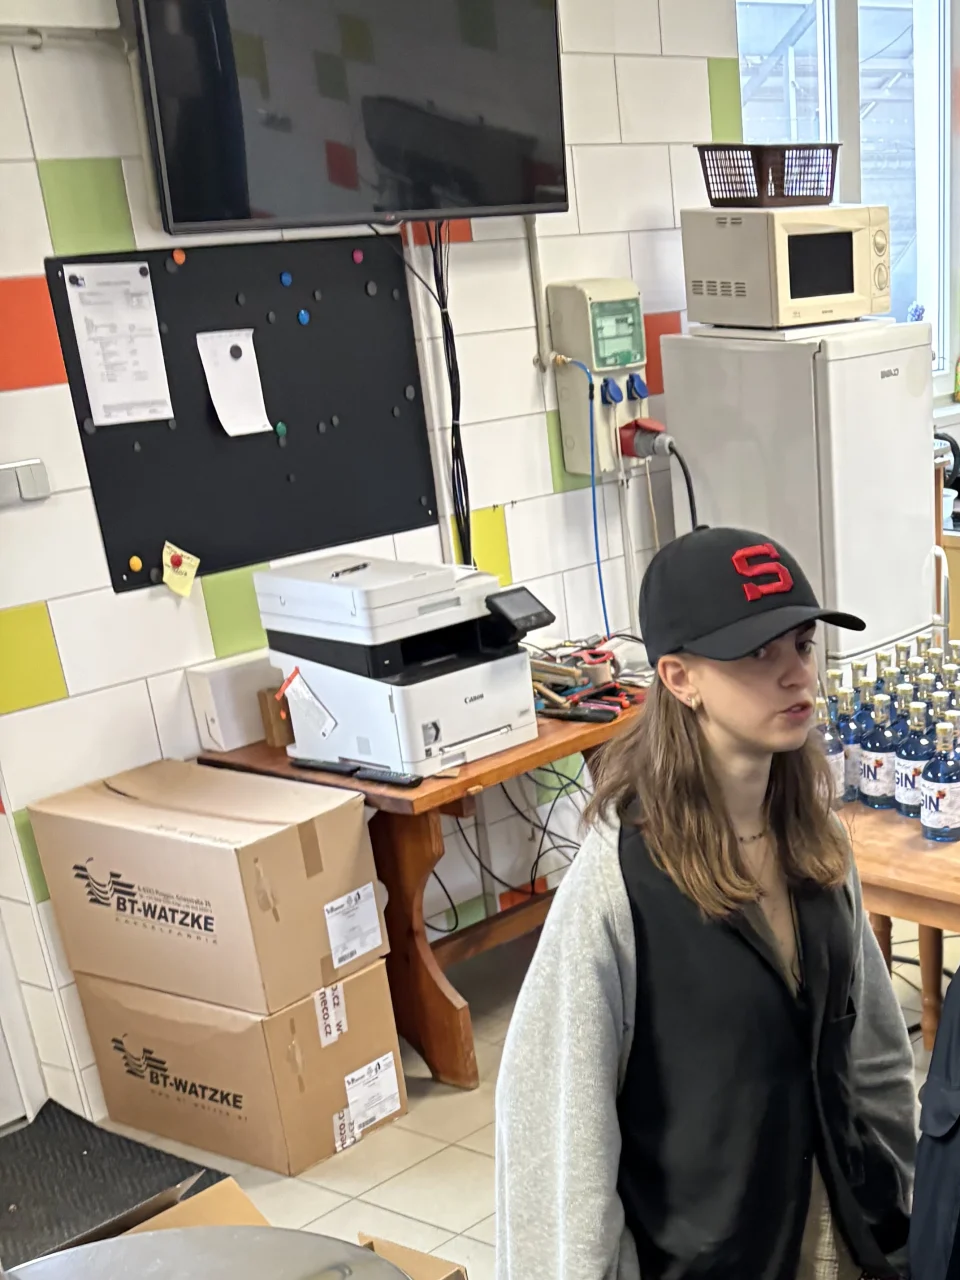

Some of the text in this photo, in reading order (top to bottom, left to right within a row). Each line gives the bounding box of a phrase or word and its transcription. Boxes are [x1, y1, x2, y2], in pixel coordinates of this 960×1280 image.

[731, 543, 794, 602] S
[116, 895, 215, 933] BT-WATZKE
[149, 1070, 243, 1110] BT-WATZKE
